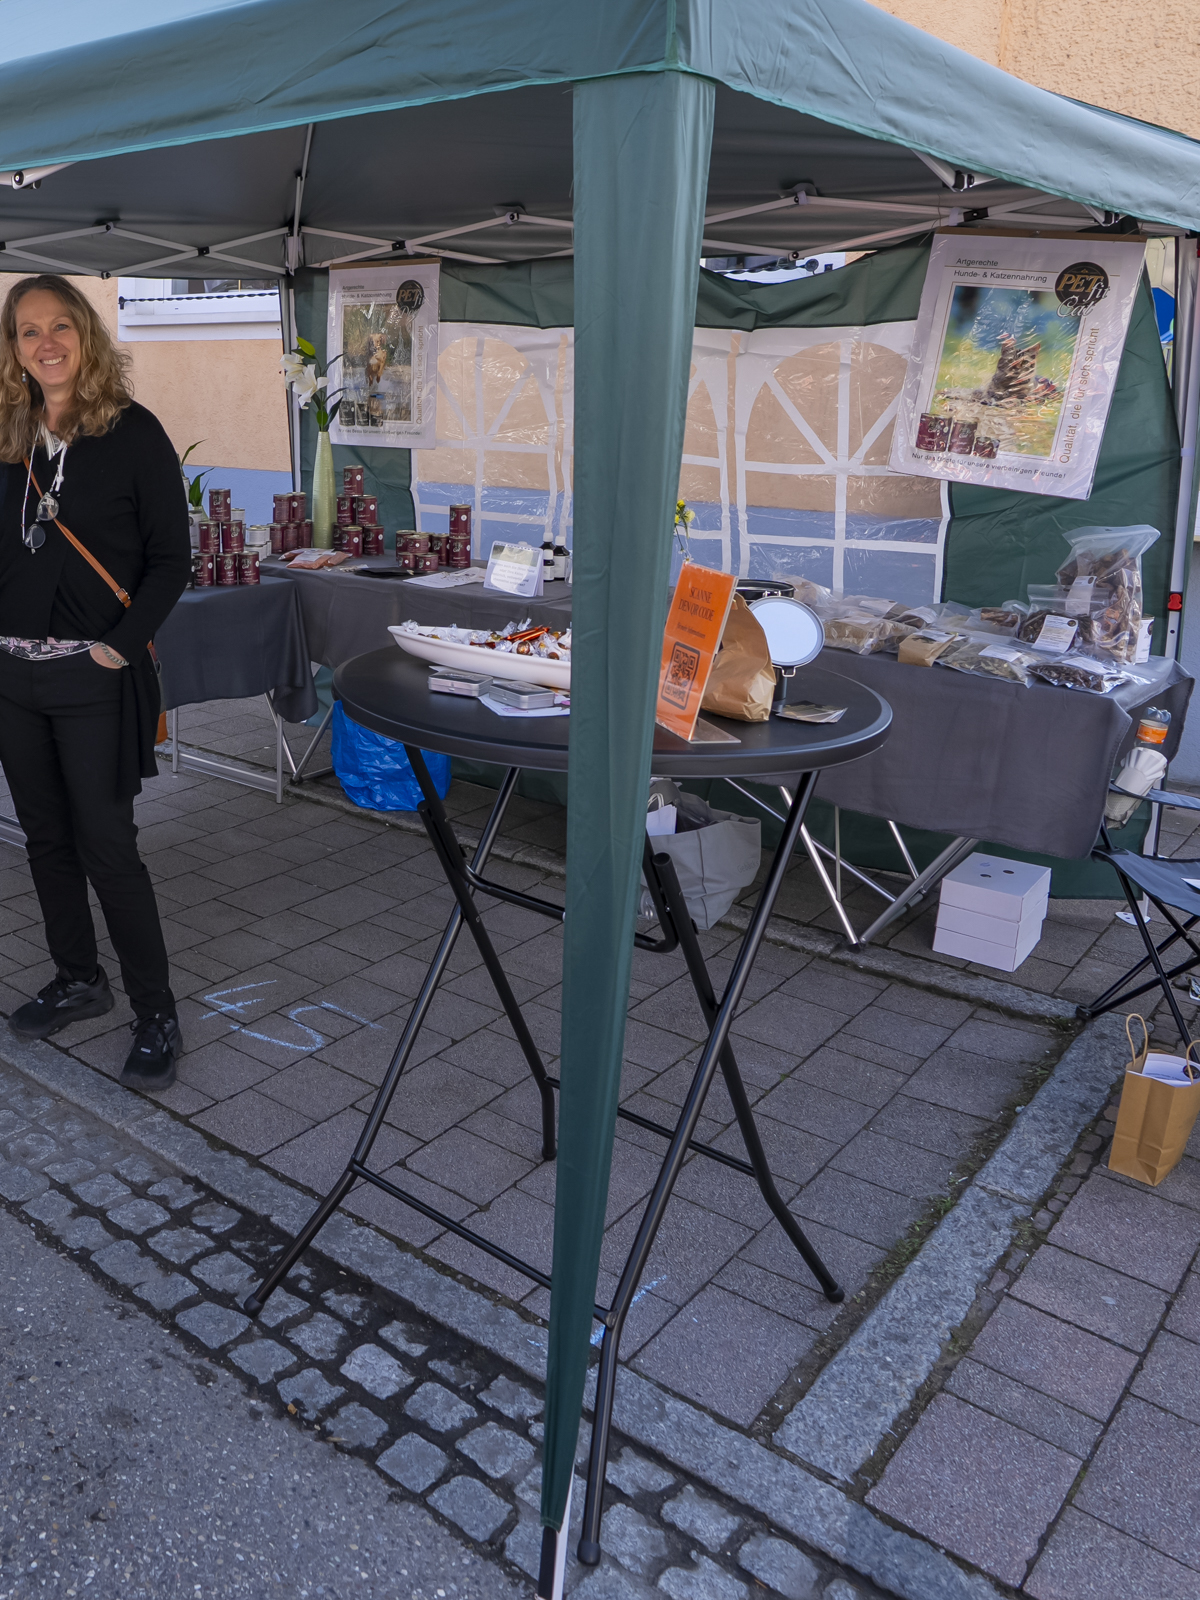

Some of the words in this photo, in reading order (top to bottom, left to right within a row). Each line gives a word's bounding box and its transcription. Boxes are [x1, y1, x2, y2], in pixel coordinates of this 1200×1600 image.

[956, 257, 999, 267] Artgerechte
[954, 270, 981, 278] Hunde-
[989, 271, 1048, 284] Katzennahrung
[1056, 273, 1104, 293] PET
[398, 289, 420, 302] PET
[1056, 294, 1097, 318] Cat
[1084, 327, 1100, 362] spricht
[1079, 364, 1090, 385] sich
[1070, 403, 1082, 420] die
[1059, 422, 1079, 464] Qualität,
[912, 452, 923, 460] Nur
[689, 586, 713, 604] SCANNE
[678, 598, 690, 612] DEN
[698, 605, 715, 622] CODE
